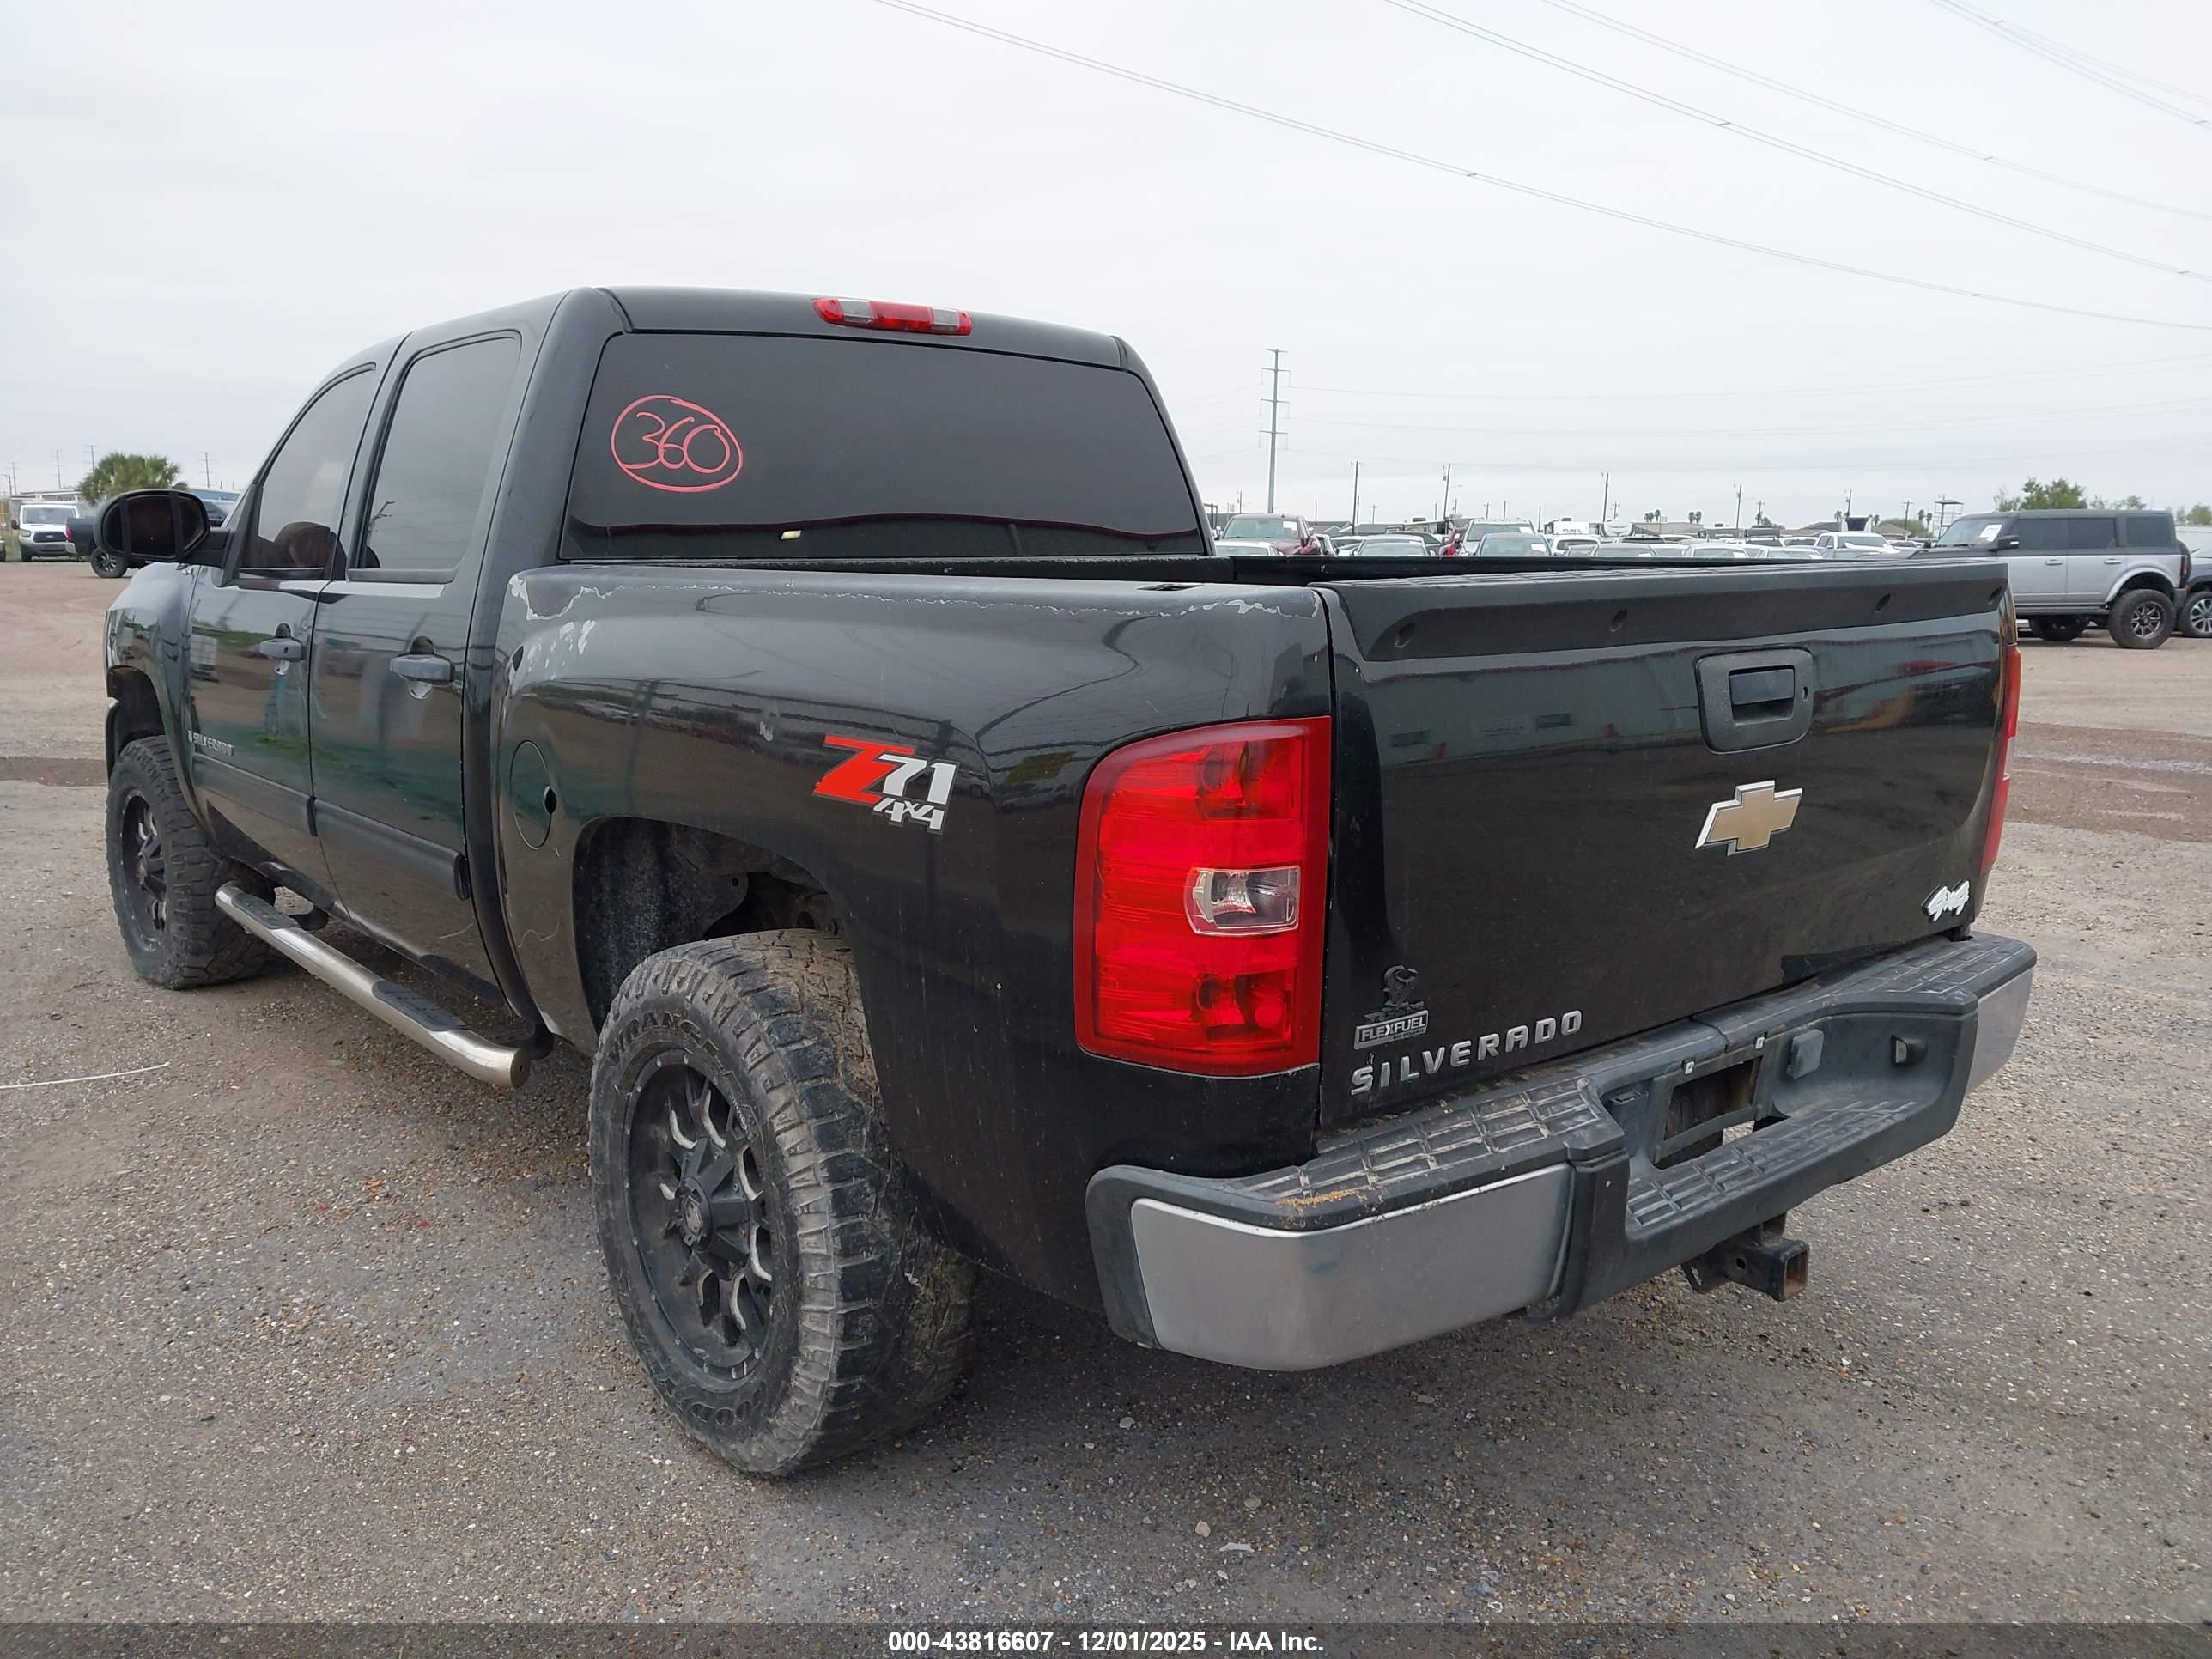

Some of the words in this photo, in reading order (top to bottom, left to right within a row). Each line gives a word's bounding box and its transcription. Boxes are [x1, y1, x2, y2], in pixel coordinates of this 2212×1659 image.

[620, 411, 731, 474] 360
[812, 734, 957, 805] Z71
[1350, 1009, 1583, 1097] SILVERADO
[1360, 1016, 1427, 1042] FLEXFUEL
